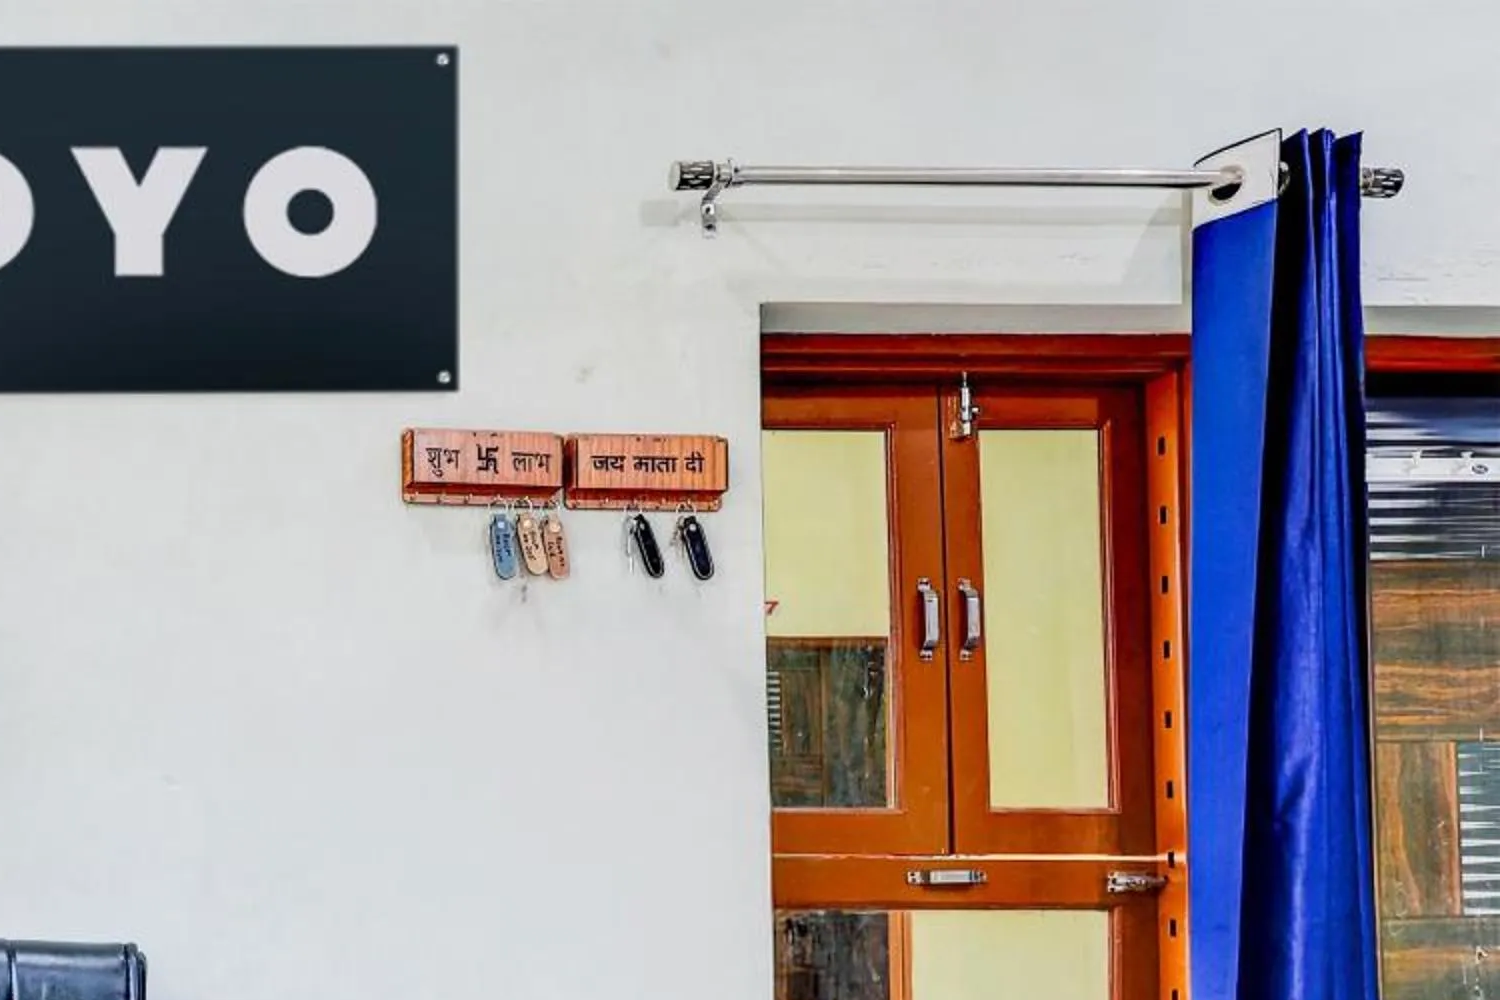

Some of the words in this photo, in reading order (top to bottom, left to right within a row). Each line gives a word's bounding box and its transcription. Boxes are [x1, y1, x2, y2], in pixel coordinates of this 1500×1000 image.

[425, 447, 460, 478] शुभ
[511, 451, 551, 473] लाभ
[590, 455, 626, 473] जय
[632, 455, 678, 473] माता
[684, 451, 705, 473] दी
